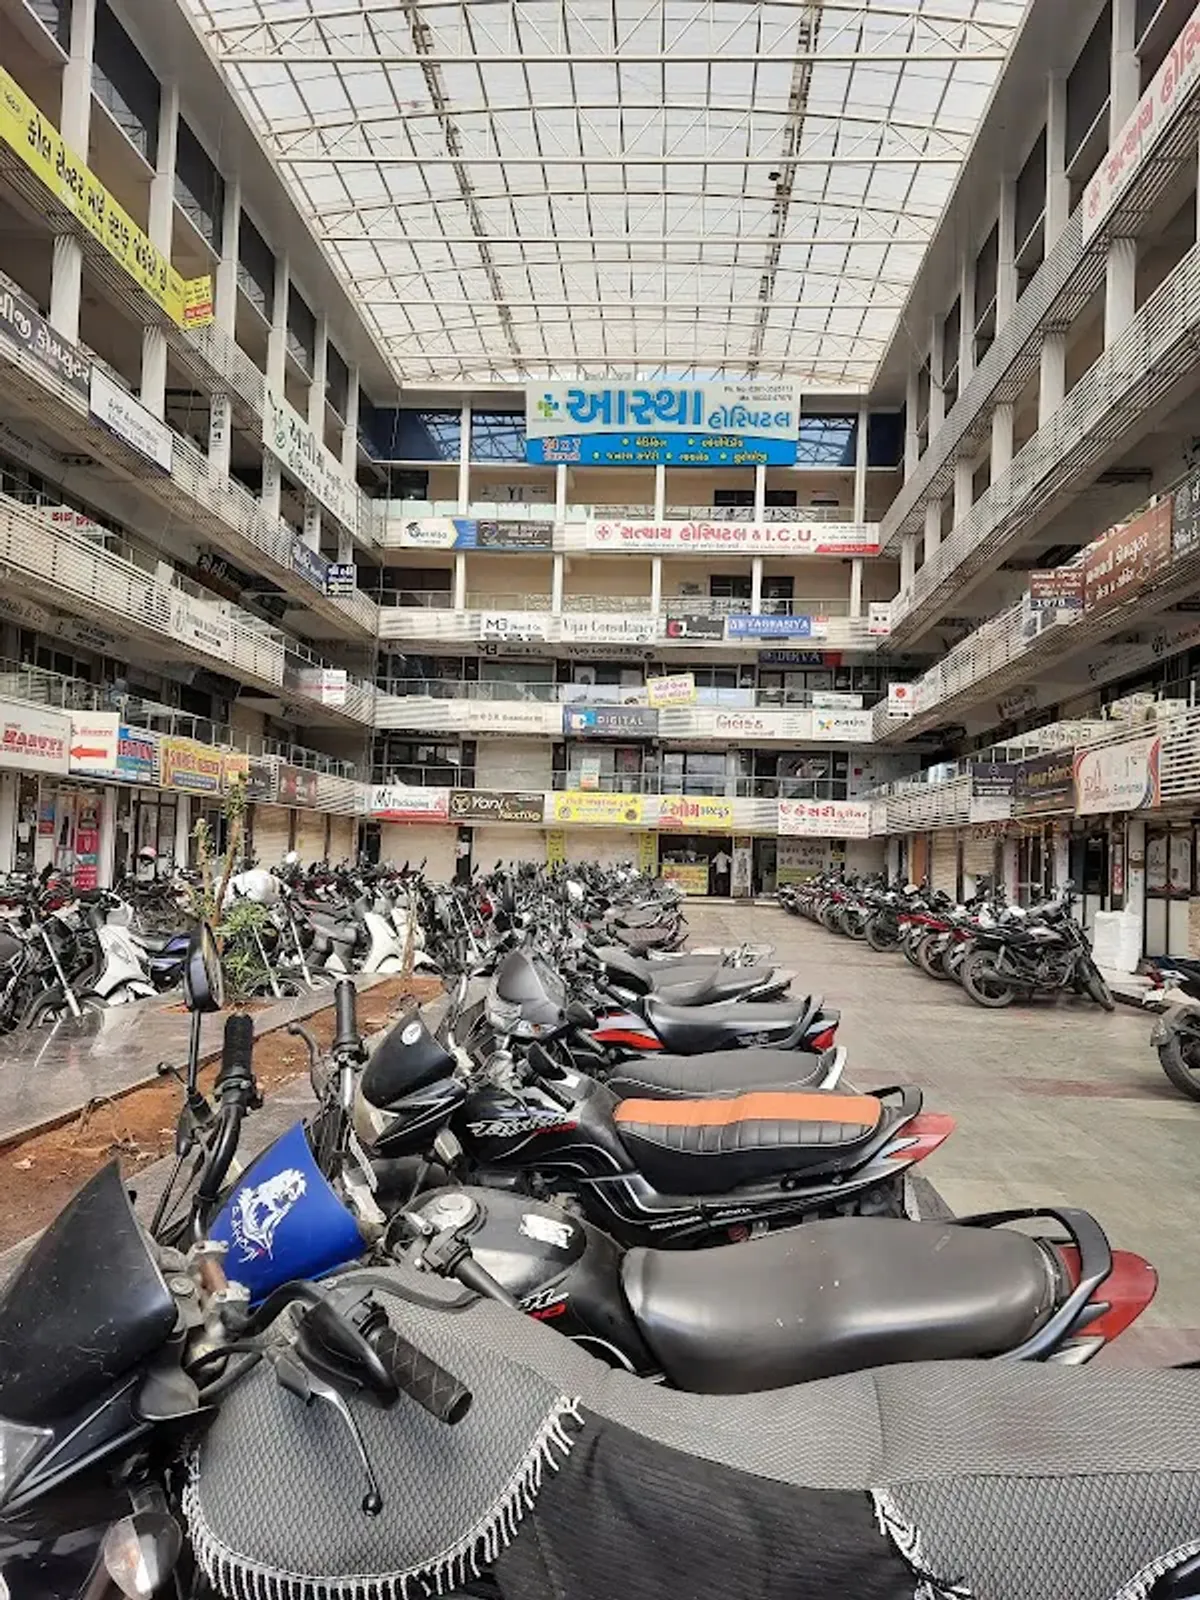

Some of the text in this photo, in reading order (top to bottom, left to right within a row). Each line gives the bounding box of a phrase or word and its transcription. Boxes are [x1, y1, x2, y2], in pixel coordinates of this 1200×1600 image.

[567, 389, 705, 425] આસ્થા
[708, 405, 791, 429] હોસ્પિટલ
[679, 523, 747, 541] હોસ્પિટલ
[766, 529, 817, 541] I.C.U.
[598, 715, 644, 726] DIGITAL
